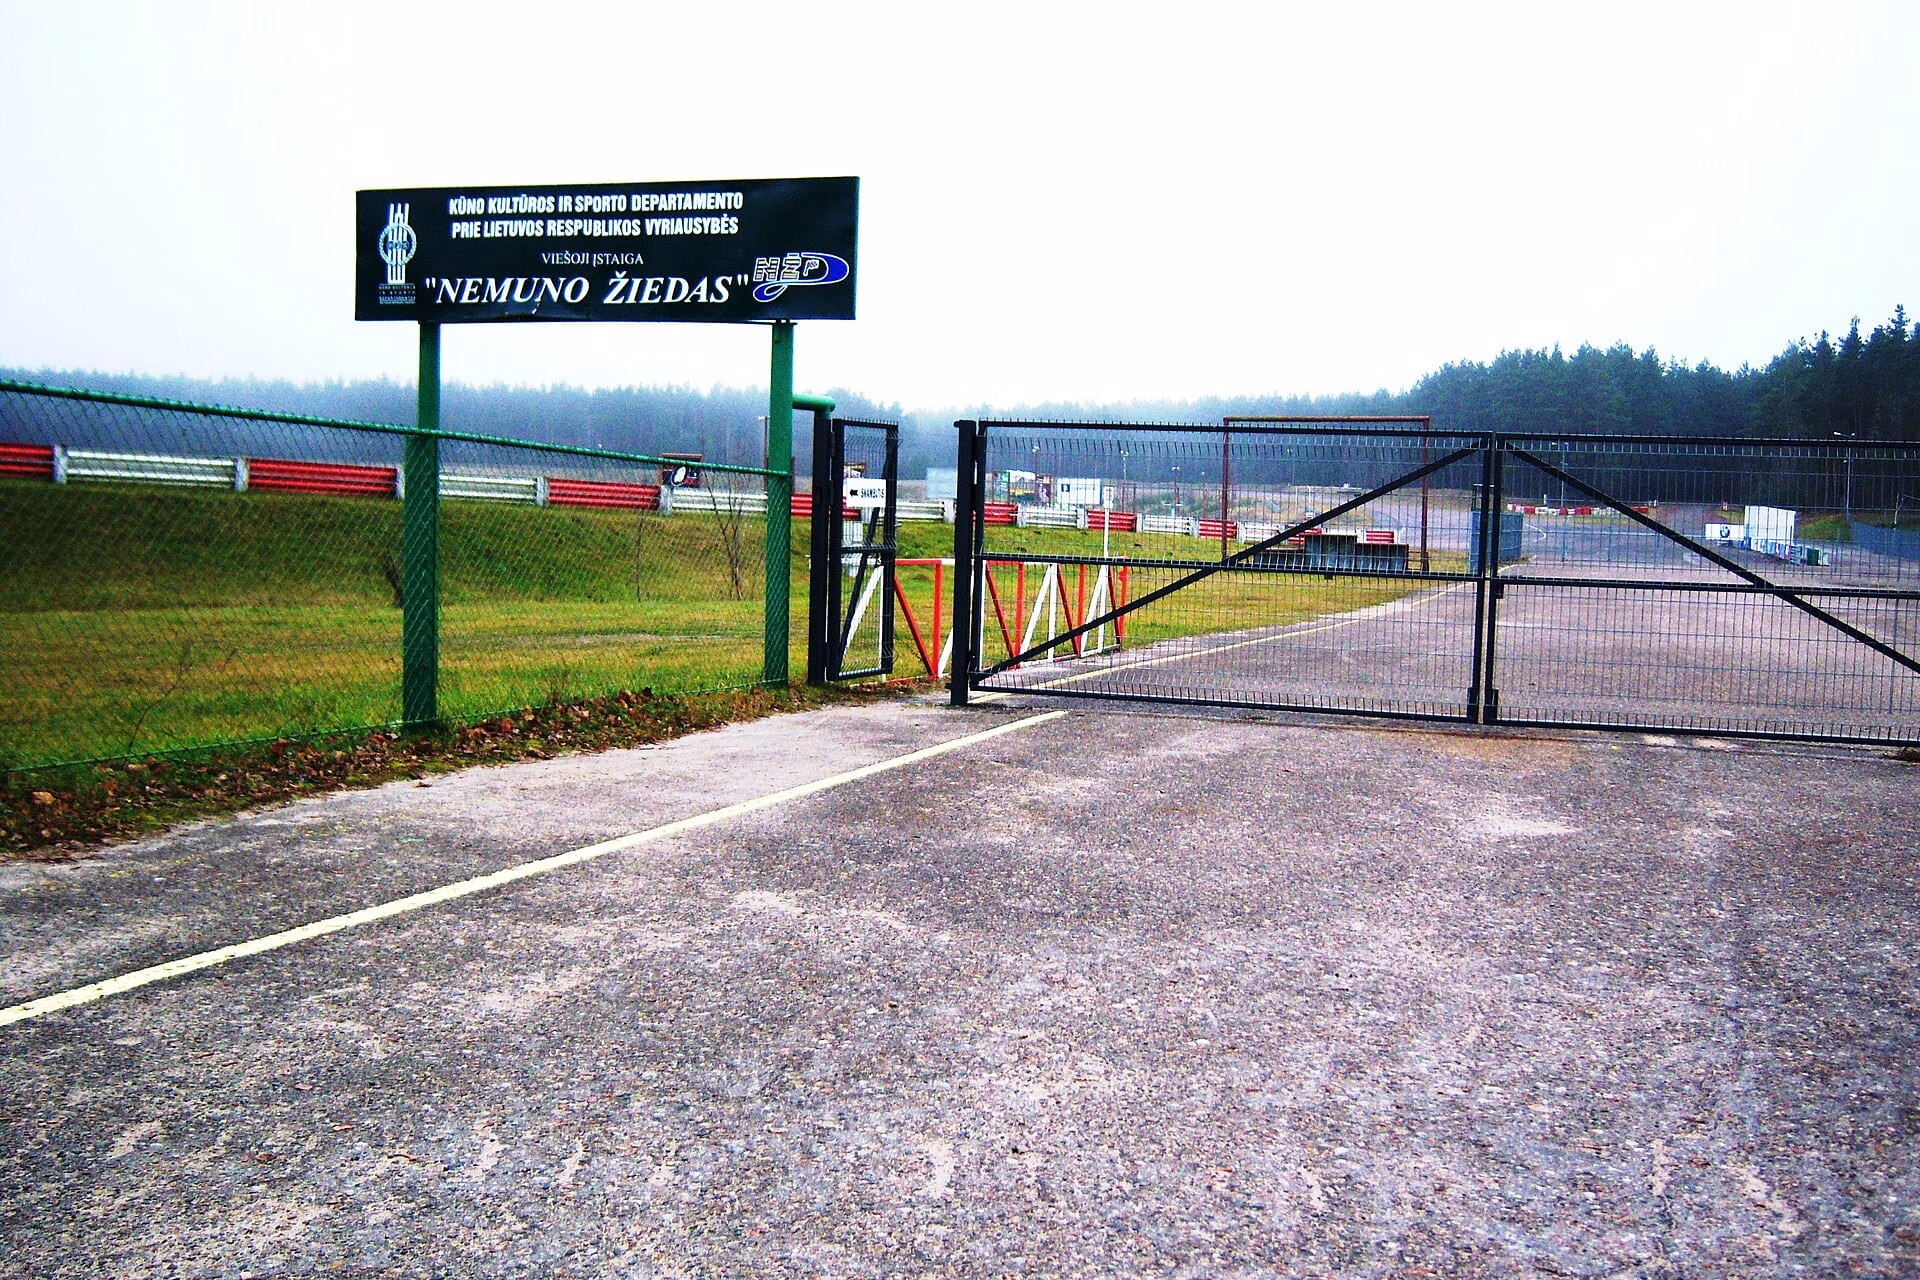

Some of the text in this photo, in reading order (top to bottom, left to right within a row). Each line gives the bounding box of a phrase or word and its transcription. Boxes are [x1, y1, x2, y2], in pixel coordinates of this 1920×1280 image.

[449, 192, 744, 215] KŪNO KULTŪROS IR SPORTO DEPARTAMENTO
[452, 213, 739, 239] PRIE LIETUVOS RESPUBLIKOS VYRIAUSYBĖS
[541, 250, 644, 267] VIEŠOJI ĮSTAIGA
[425, 270, 749, 304] "NEMUNO ŽIEDAS"
